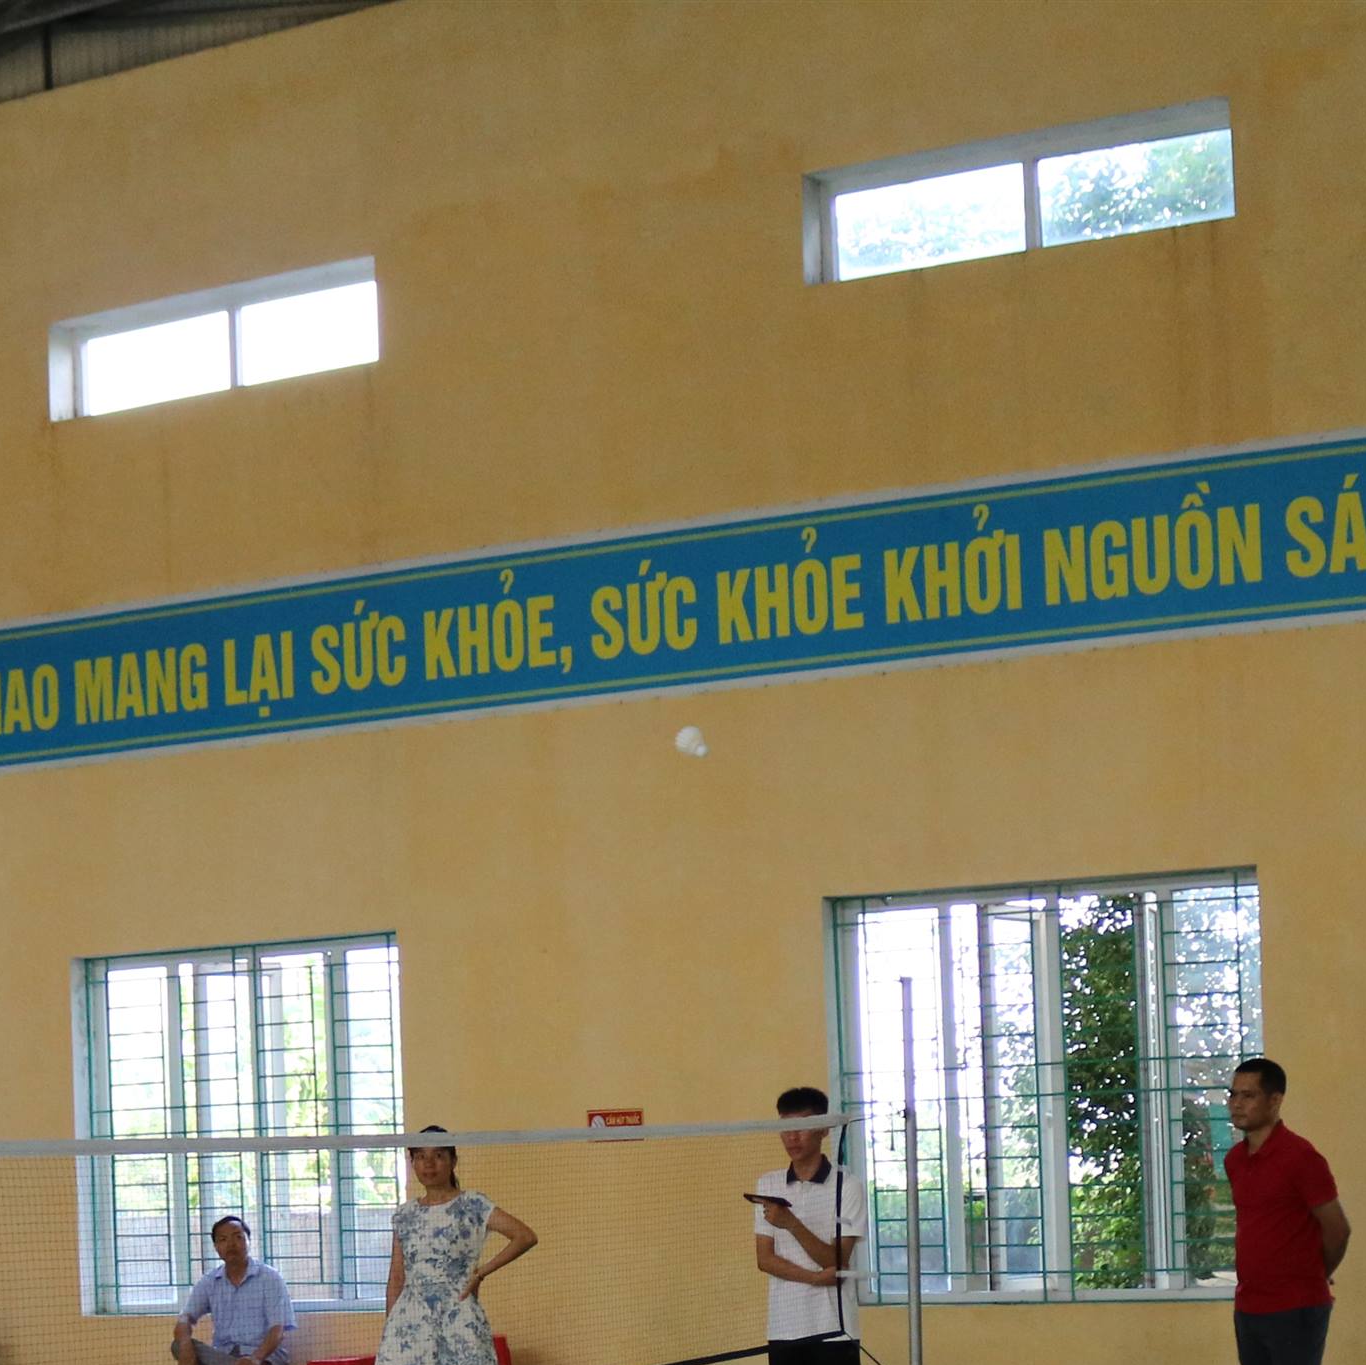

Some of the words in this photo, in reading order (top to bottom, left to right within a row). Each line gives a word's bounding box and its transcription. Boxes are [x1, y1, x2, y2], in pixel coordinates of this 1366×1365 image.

[73, 644, 208, 725] MANG
[224, 632, 295, 717] LẠI
[311, 599, 407, 695] SỨC
[423, 569, 573, 680] KHỎE,
[592, 559, 698, 660] SỨC
[717, 527, 864, 644] KHỎE
[884, 504, 1022, 624] KHỞI
[1043, 479, 1263, 605] NGUỒN
